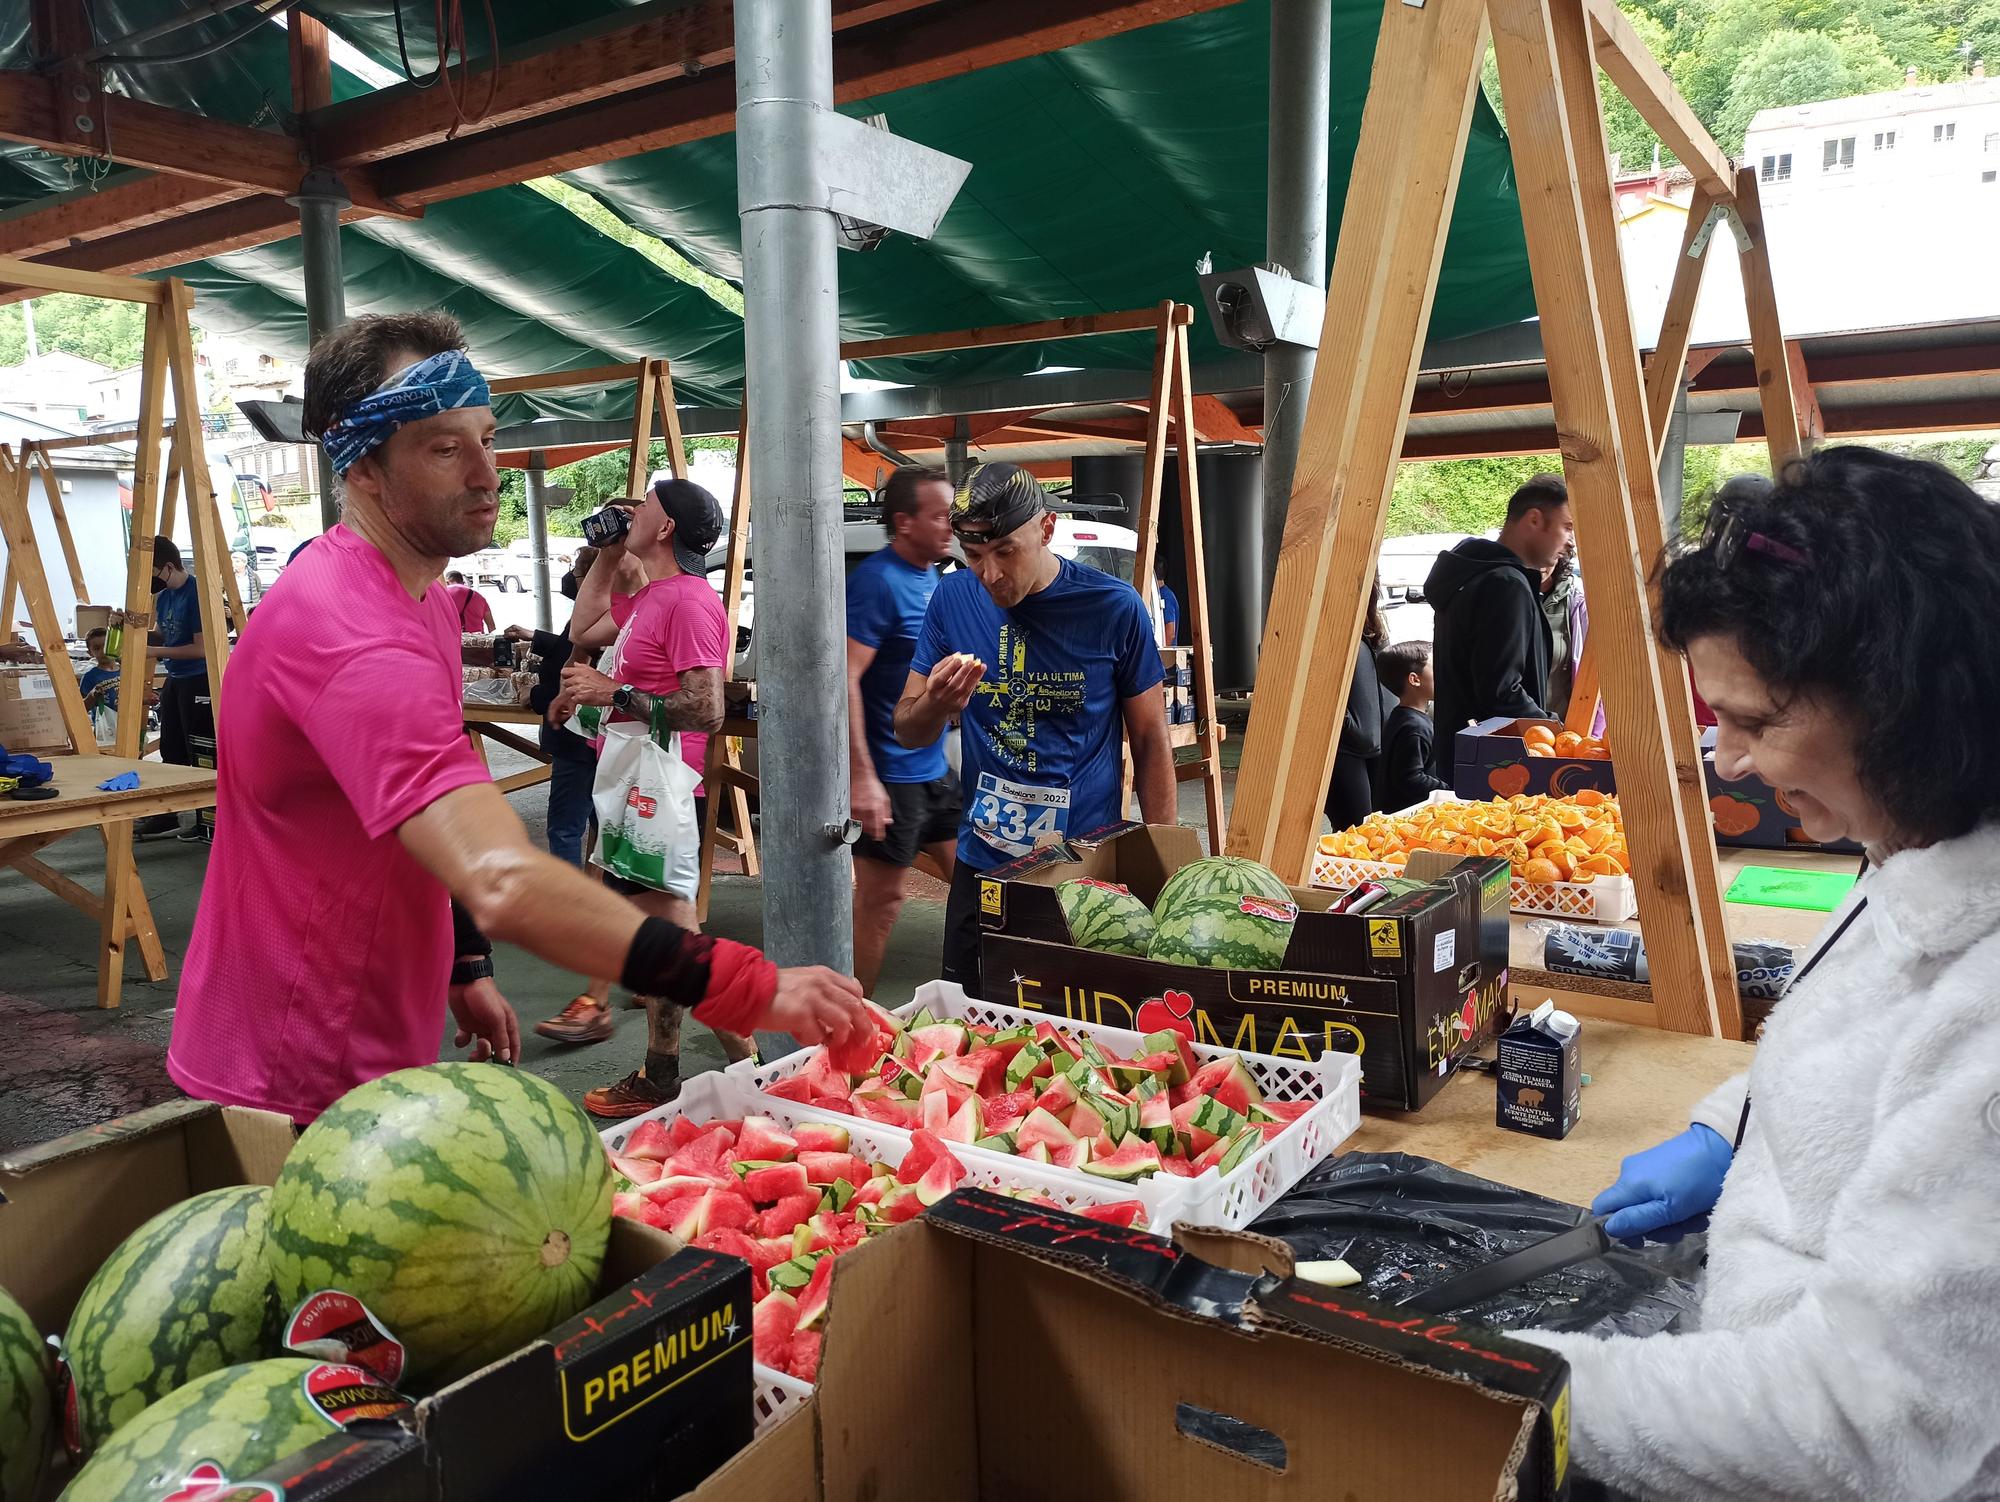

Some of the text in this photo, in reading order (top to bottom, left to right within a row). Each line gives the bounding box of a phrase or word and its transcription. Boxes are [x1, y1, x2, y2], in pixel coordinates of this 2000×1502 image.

[998, 624, 1009, 680] LA PRIMERA
[1027, 672, 1035, 681] Y
[1036, 672, 1049, 682] LA
[1026, 701, 1037, 773] 2022 ASTURIAS
[1043, 793, 1067, 804] 2022
[974, 794, 1057, 841] 334
[1737, 963, 1796, 982] SACO
[1249, 978, 1347, 1001] PREMIUM
[1504, 1108, 1527, 1118] FUENTE
[1509, 1104, 1551, 1117] MANANTIAL
[584, 1302, 734, 1416] PREMIUM
